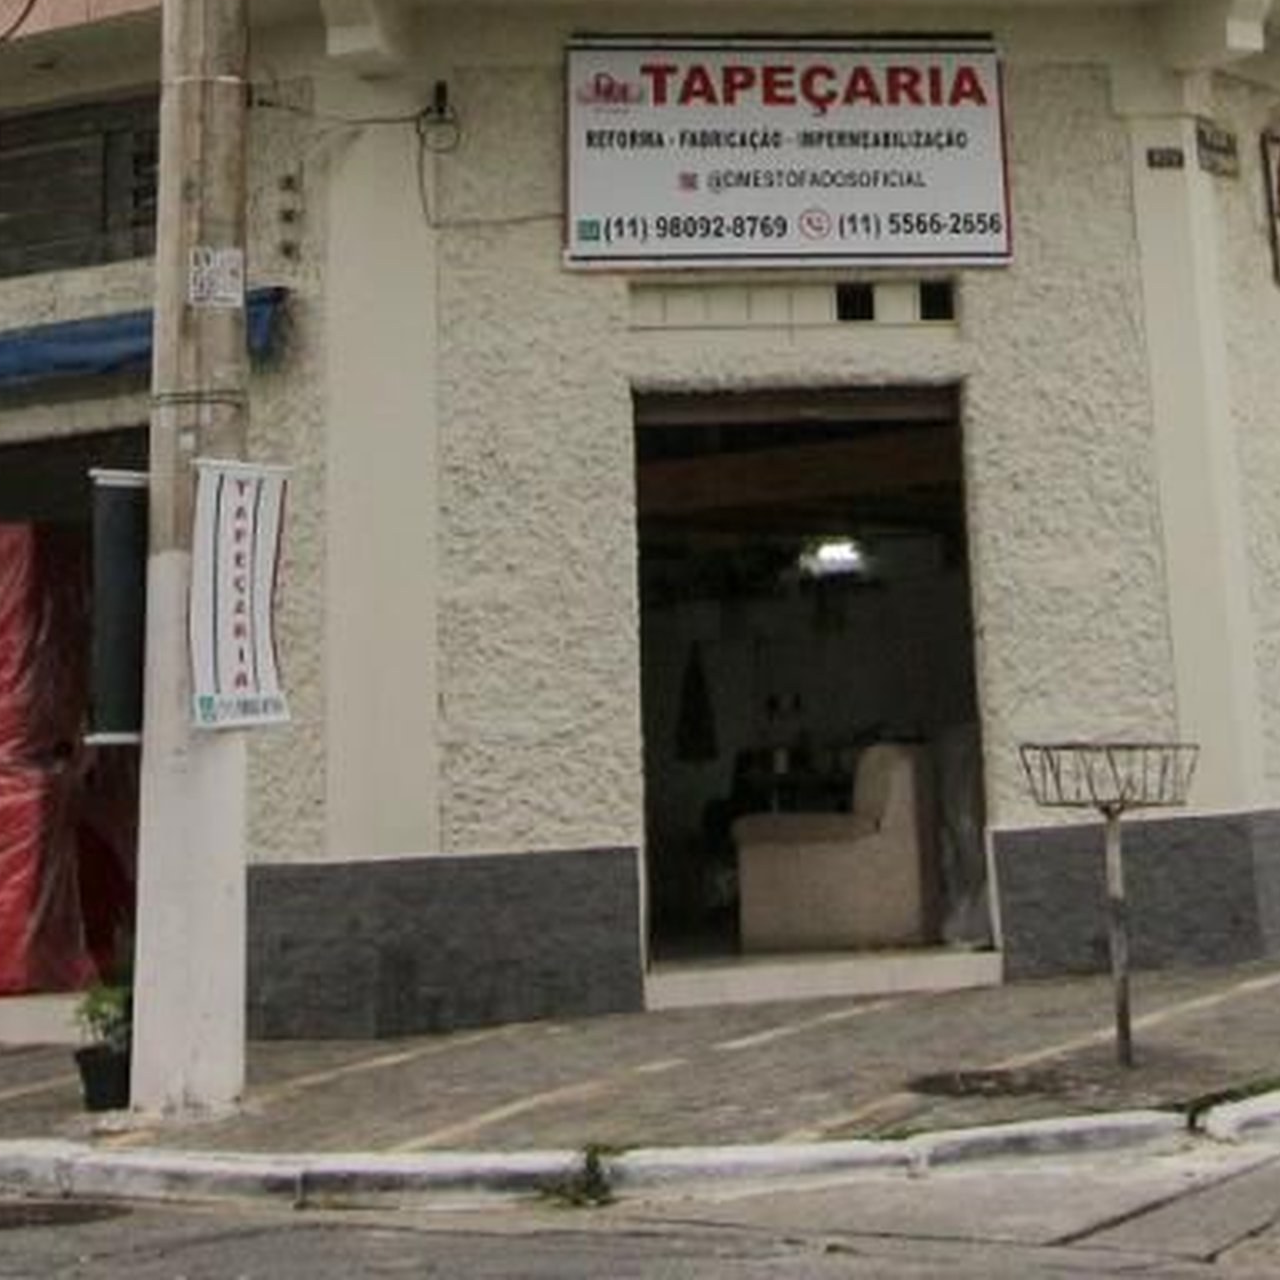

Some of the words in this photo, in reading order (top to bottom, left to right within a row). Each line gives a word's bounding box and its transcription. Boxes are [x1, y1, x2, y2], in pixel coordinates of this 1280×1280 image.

[640, 64, 988, 117] TAPEÇARIA
[586, 130, 665, 149] REFORMA
[679, 125, 783, 152] FABRICAÇÃO
[799, 127, 968, 150] IMPERMEABILIZAÇÃO
[604, 216, 649, 242] (11)
[656, 215, 788, 238] 98092-8769
[839, 213, 881, 239] (11)
[888, 213, 1002, 237] 5566-2656
